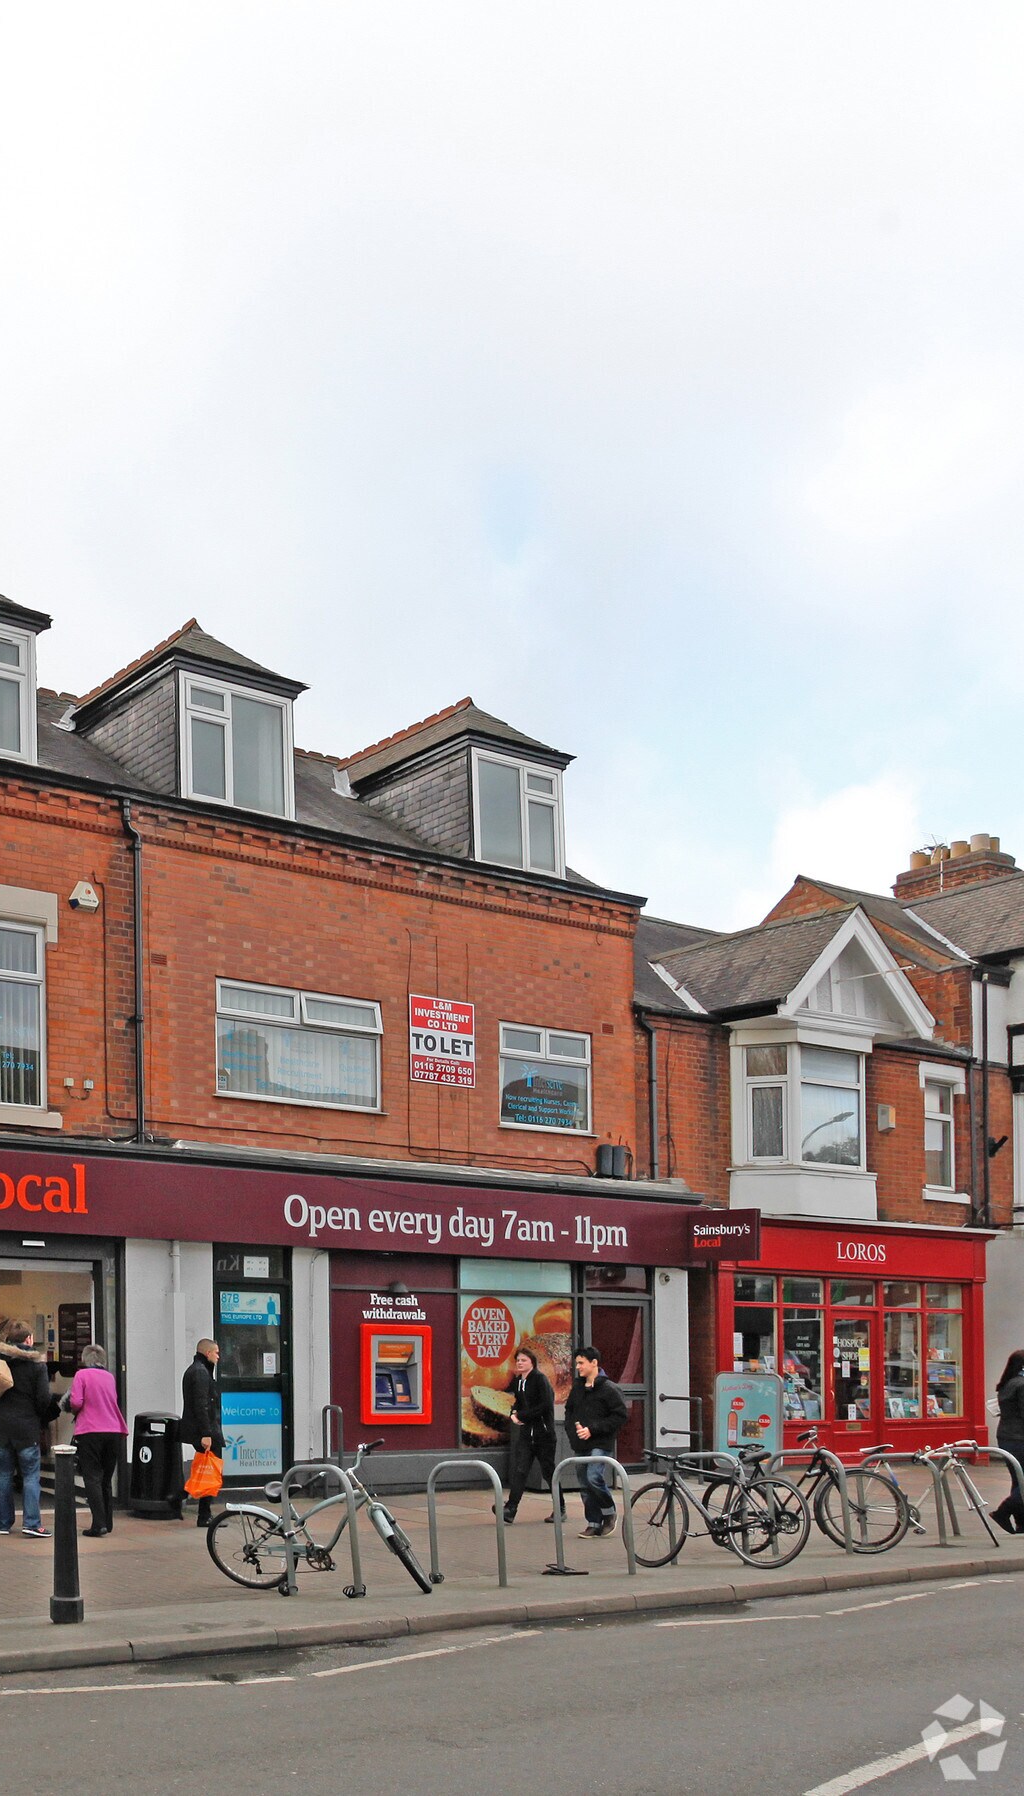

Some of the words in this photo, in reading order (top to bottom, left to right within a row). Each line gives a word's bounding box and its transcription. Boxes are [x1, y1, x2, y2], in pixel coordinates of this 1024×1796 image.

[433, 1000, 452, 1011] L&M
[414, 1007, 470, 1024] INVESTMENT
[427, 1019, 440, 1029] CO
[441, 1021, 458, 1031] LTD
[411, 1032, 437, 1052] TO
[440, 1036, 473, 1057] LET
[414, 1061, 434, 1071] 0116
[436, 1063, 456, 1074] 2709
[457, 1066, 472, 1076] 650
[414, 1070, 439, 1080] 07787
[441, 1074, 456, 1083] 432
[457, 1074, 472, 1085] 319
[284, 1194, 362, 1237] Open
[368, 1209, 442, 1244] every
[448, 1206, 495, 1247] day
[502, 1209, 555, 1242] 7am
[575, 1215, 628, 1253] 11pm
[693, 1223, 751, 1237] Sainsbury's
[693, 1236, 721, 1248] Local
[837, 1241, 886, 1262] LOROS
[221, 1292, 240, 1304] 87B
[370, 1293, 393, 1306] Free
[395, 1294, 418, 1306] cash
[362, 1308, 426, 1320] withdrawals
[471, 1307, 506, 1320] OVEN
[467, 1320, 510, 1333] BAKED
[469, 1332, 509, 1346] EVERY
[837, 1338, 864, 1348] HOSPICE
[477, 1345, 502, 1358] DAY
[222, 1407, 267, 1416] Welcome
[270, 1407, 280, 1416] to
[239, 1445, 277, 1460] Interserve
